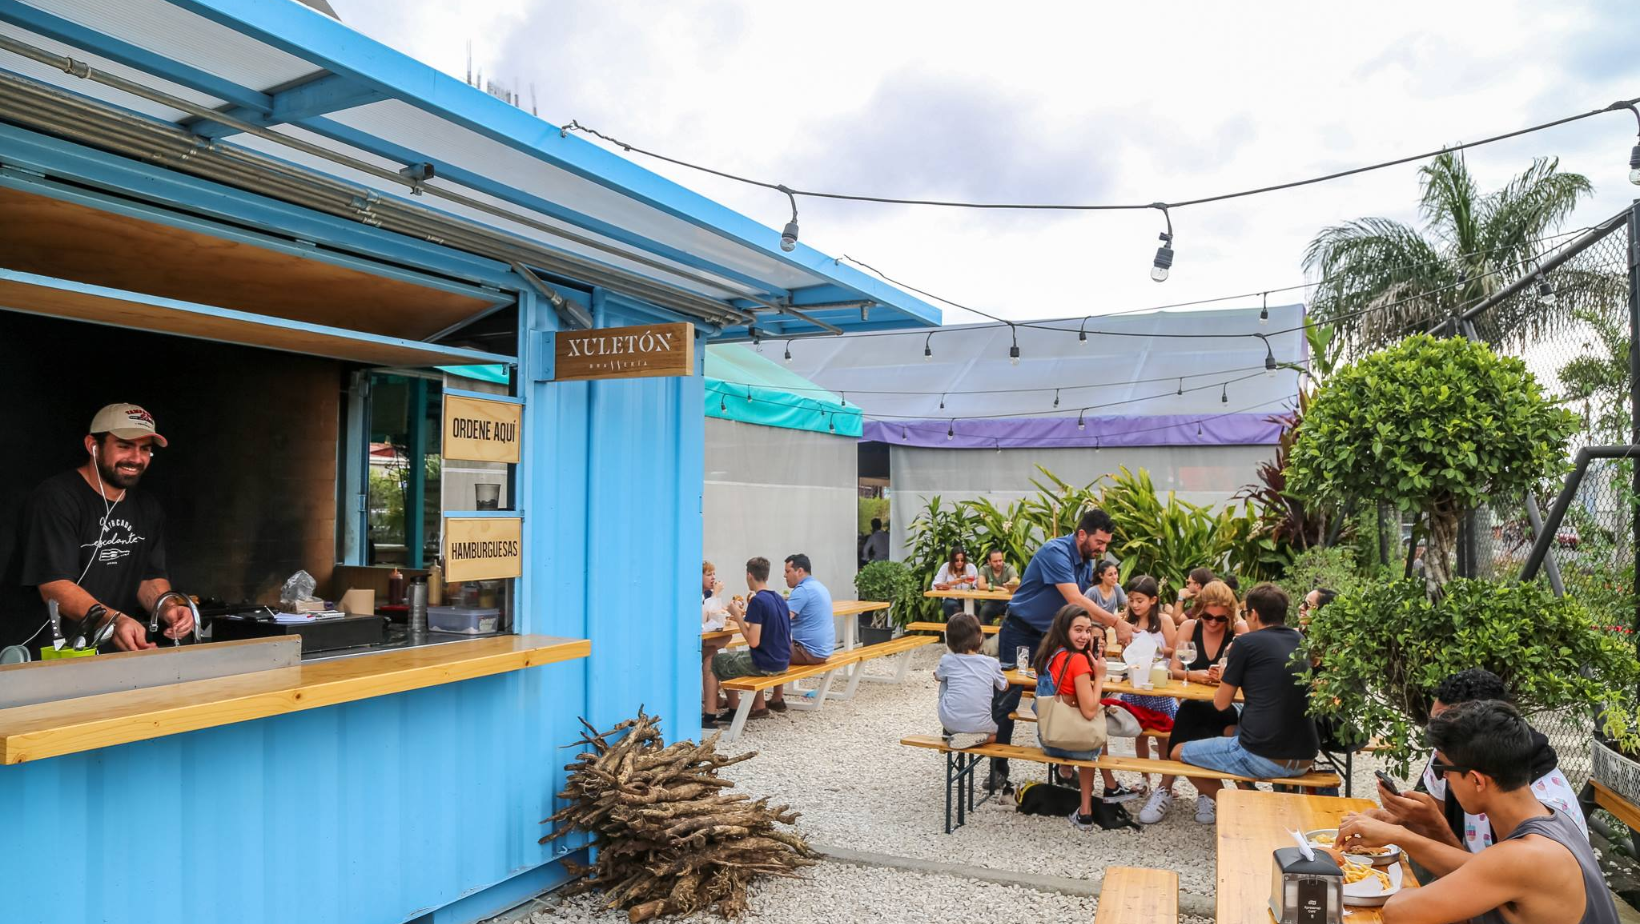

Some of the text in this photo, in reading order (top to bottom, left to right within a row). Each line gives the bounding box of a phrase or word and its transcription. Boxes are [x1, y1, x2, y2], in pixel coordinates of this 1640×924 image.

[567, 330, 672, 357] XULETÓN
[453, 417, 516, 444] ORDENE AQUÍ
[451, 540, 518, 560] HAMBURGUESAS
